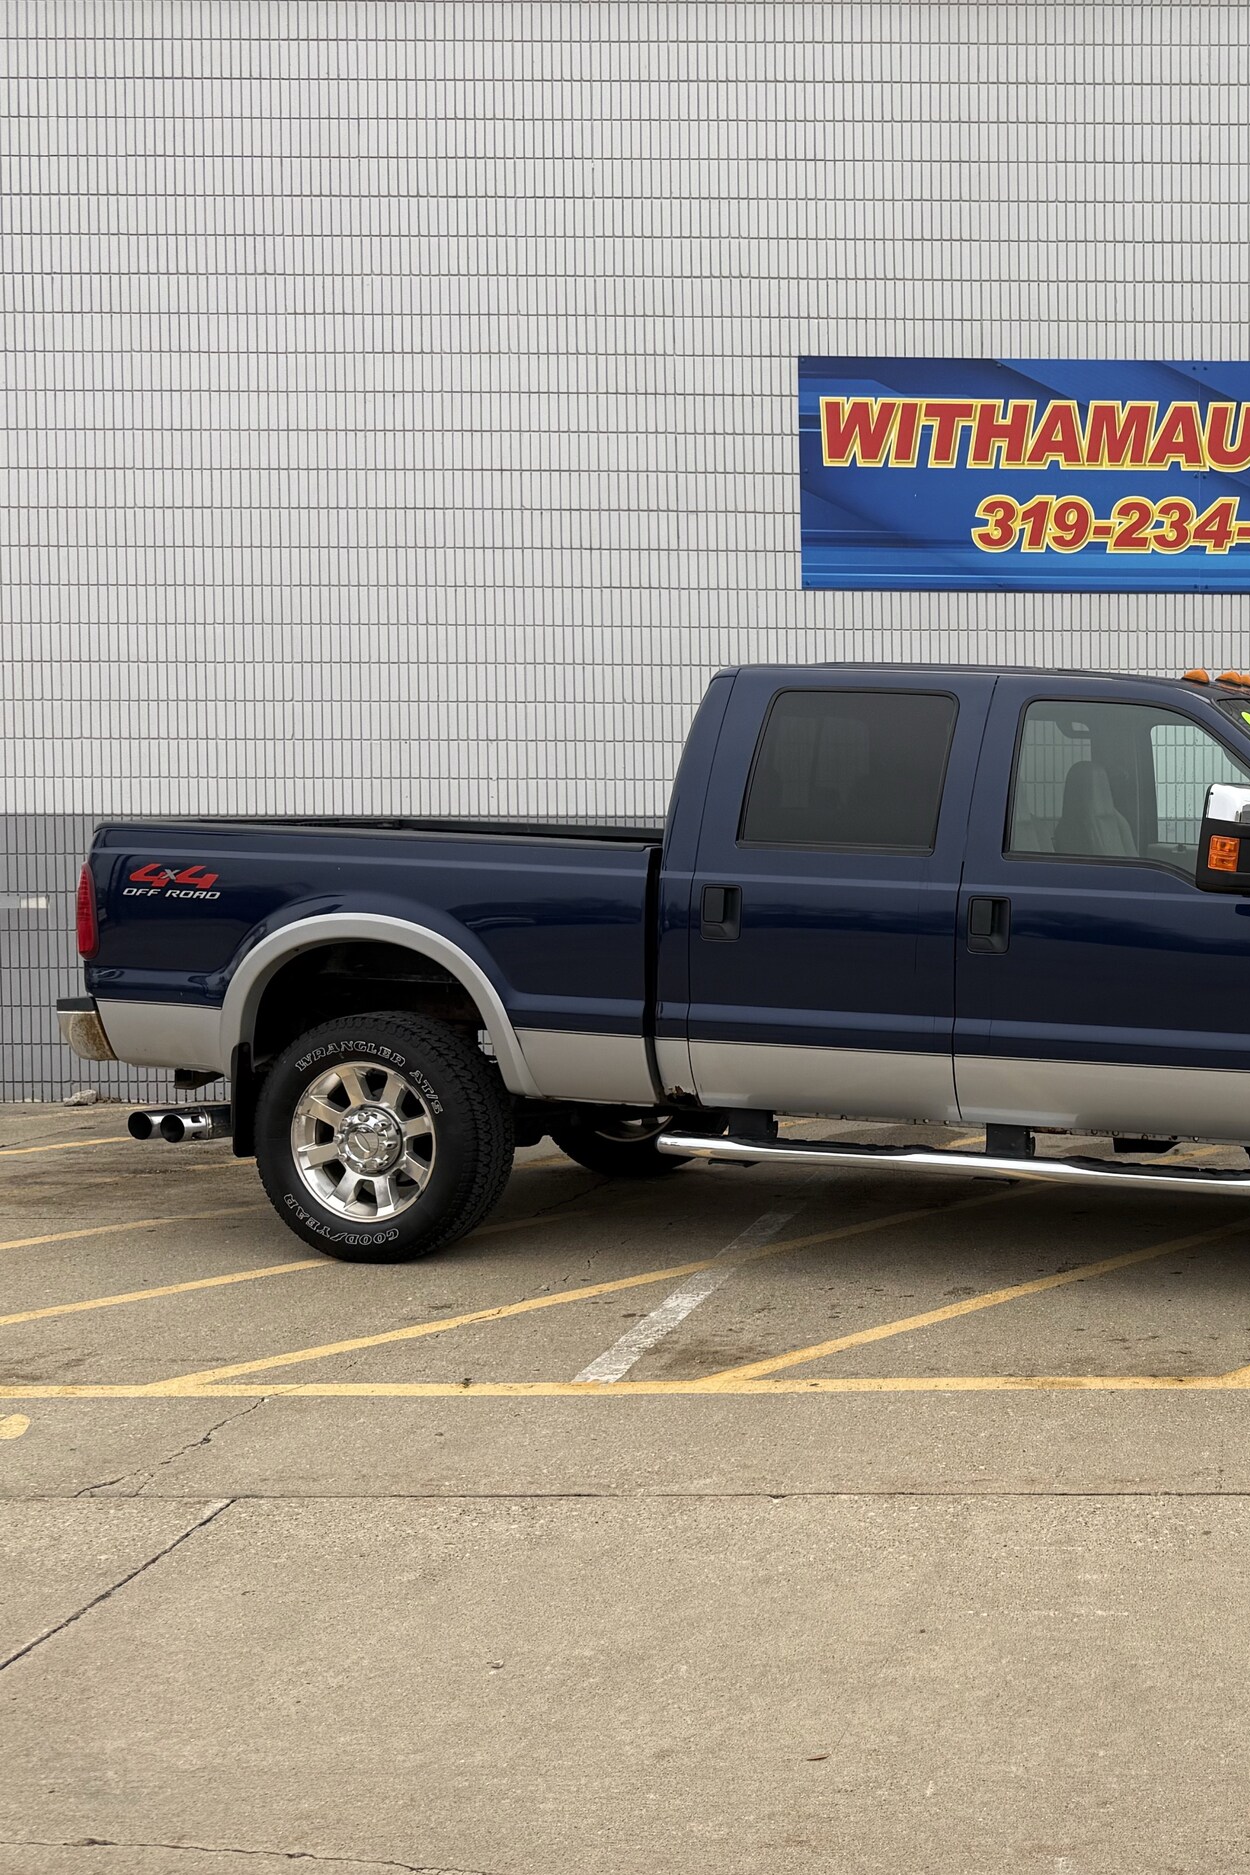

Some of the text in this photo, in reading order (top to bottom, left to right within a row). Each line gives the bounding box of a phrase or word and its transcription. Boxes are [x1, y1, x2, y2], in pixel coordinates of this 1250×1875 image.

[122, 887, 221, 900] OFF ROAD
[295, 1040, 406, 1072] WRANGLER
